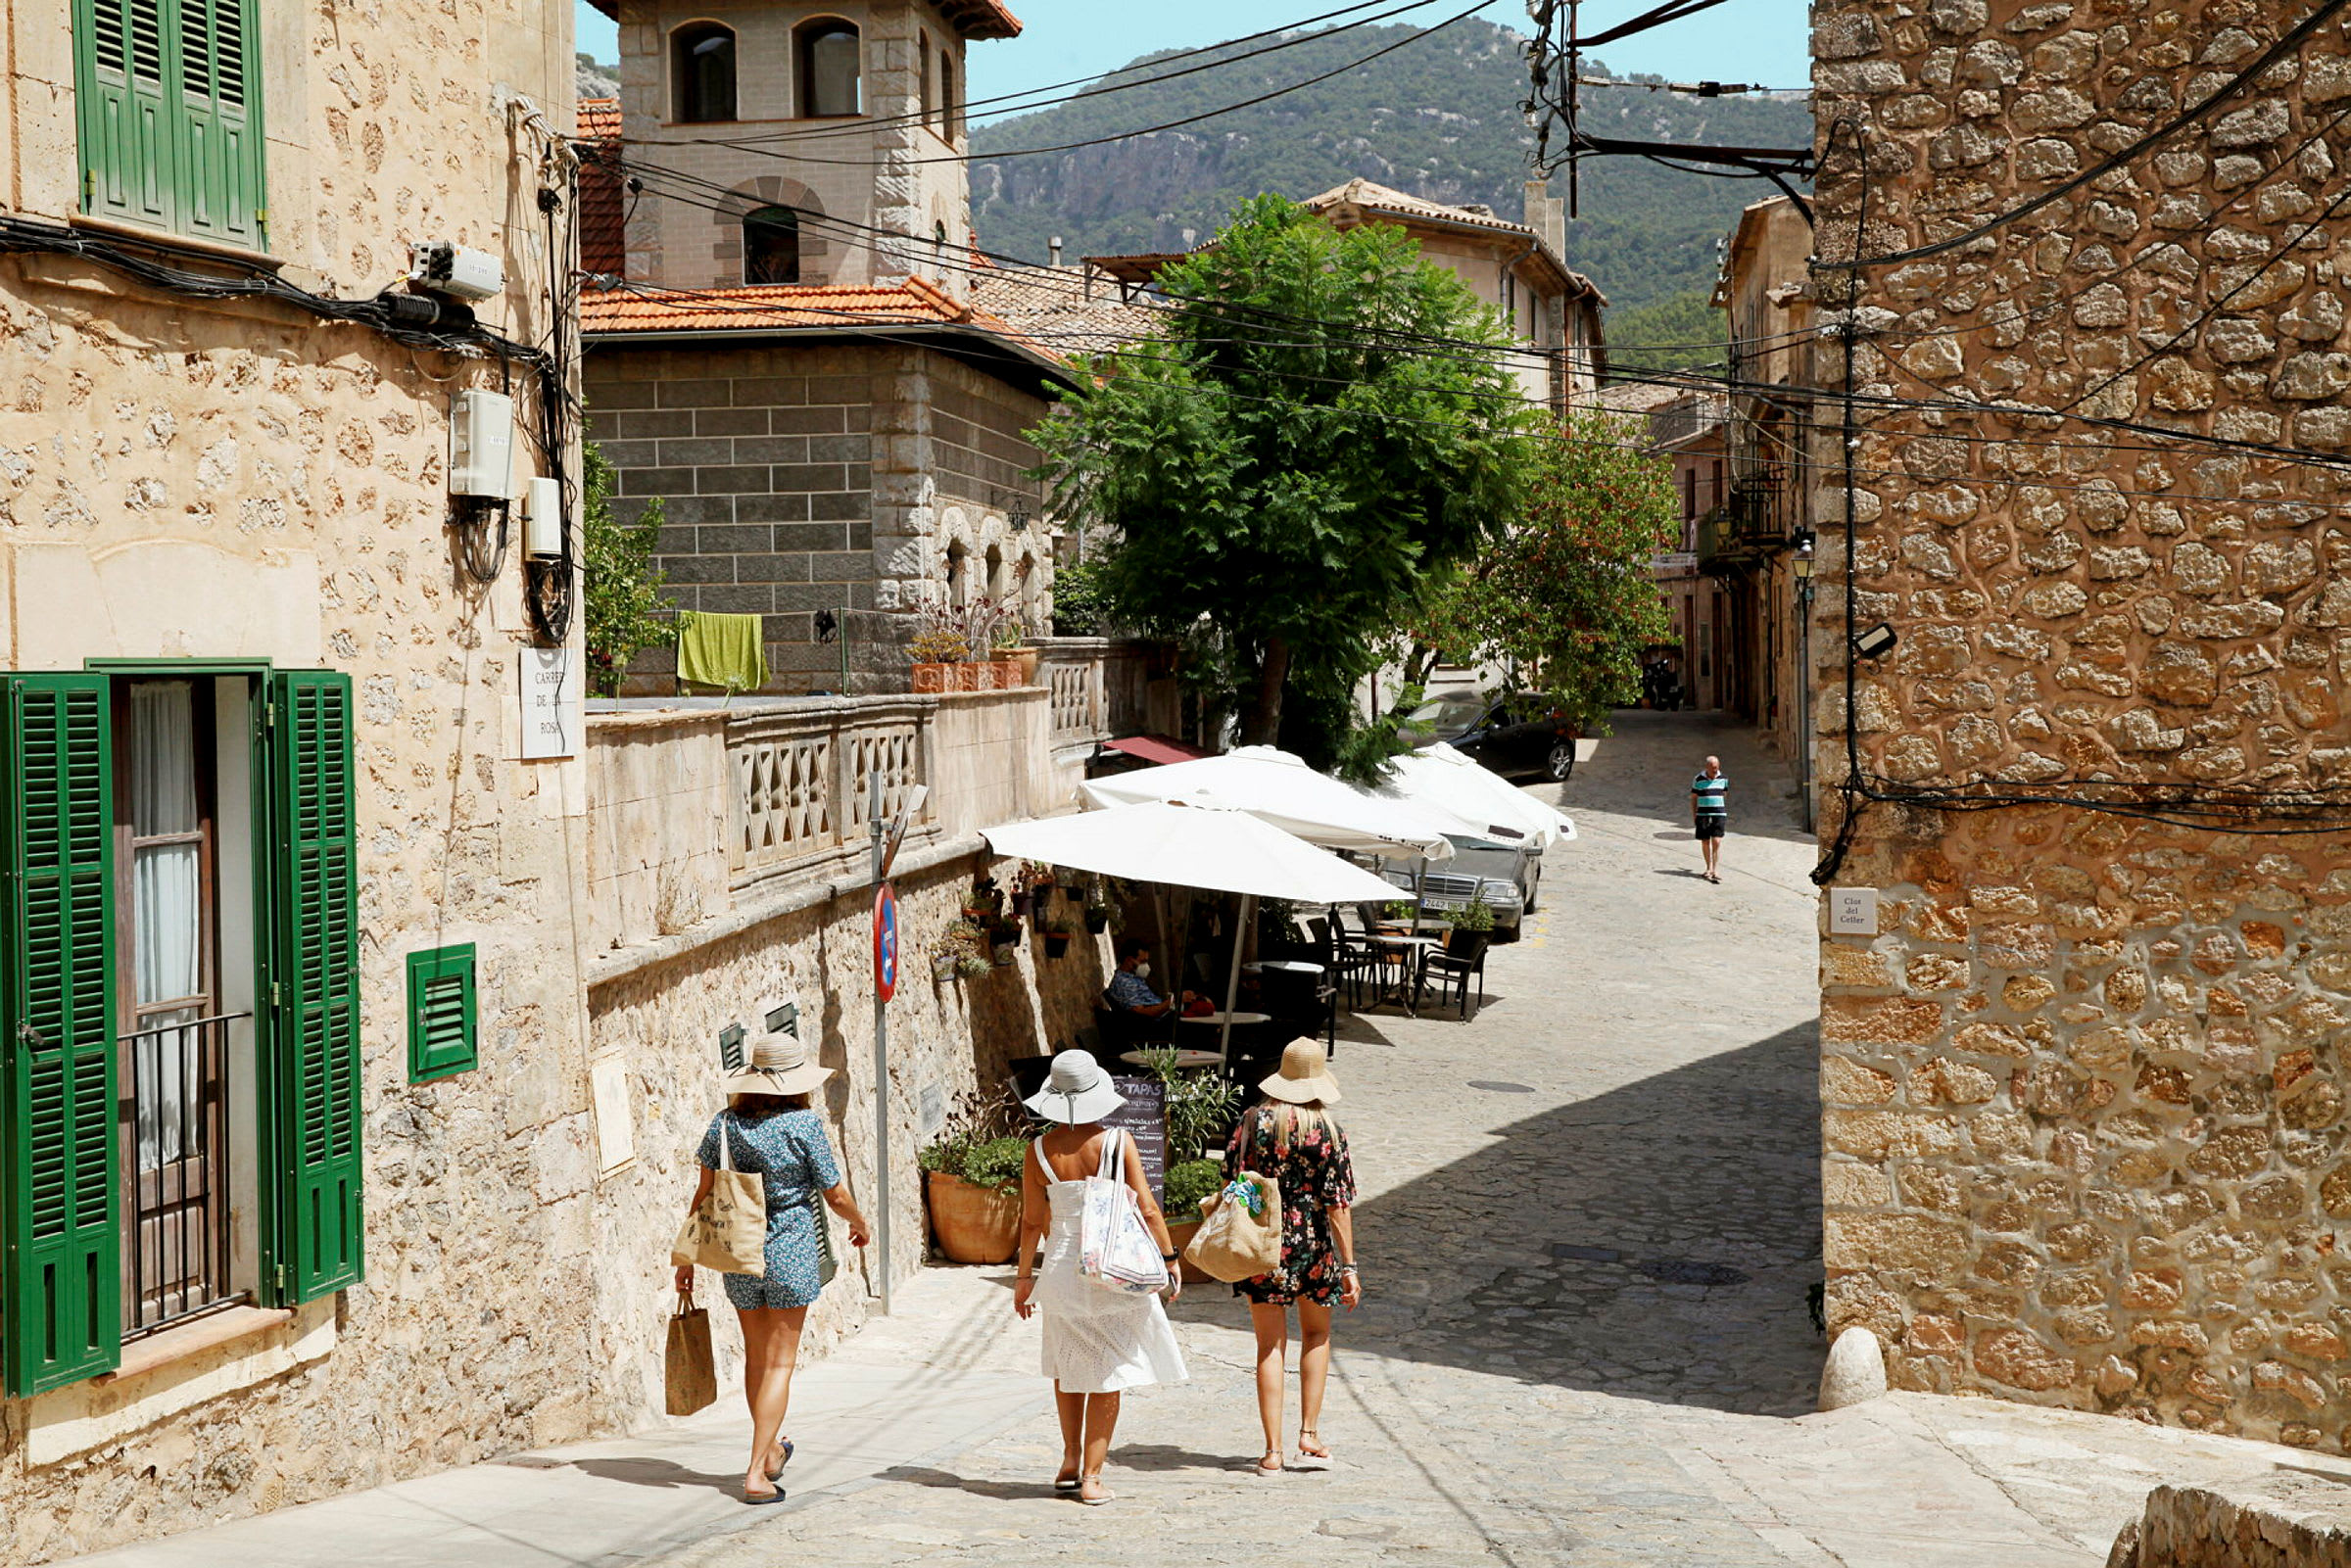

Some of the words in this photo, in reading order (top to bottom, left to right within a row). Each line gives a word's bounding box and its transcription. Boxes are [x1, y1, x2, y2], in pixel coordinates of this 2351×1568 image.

[536, 694, 548, 708] DE
[1840, 915, 1865, 925] Celler
[1125, 1083, 1162, 1096] TAPAS
